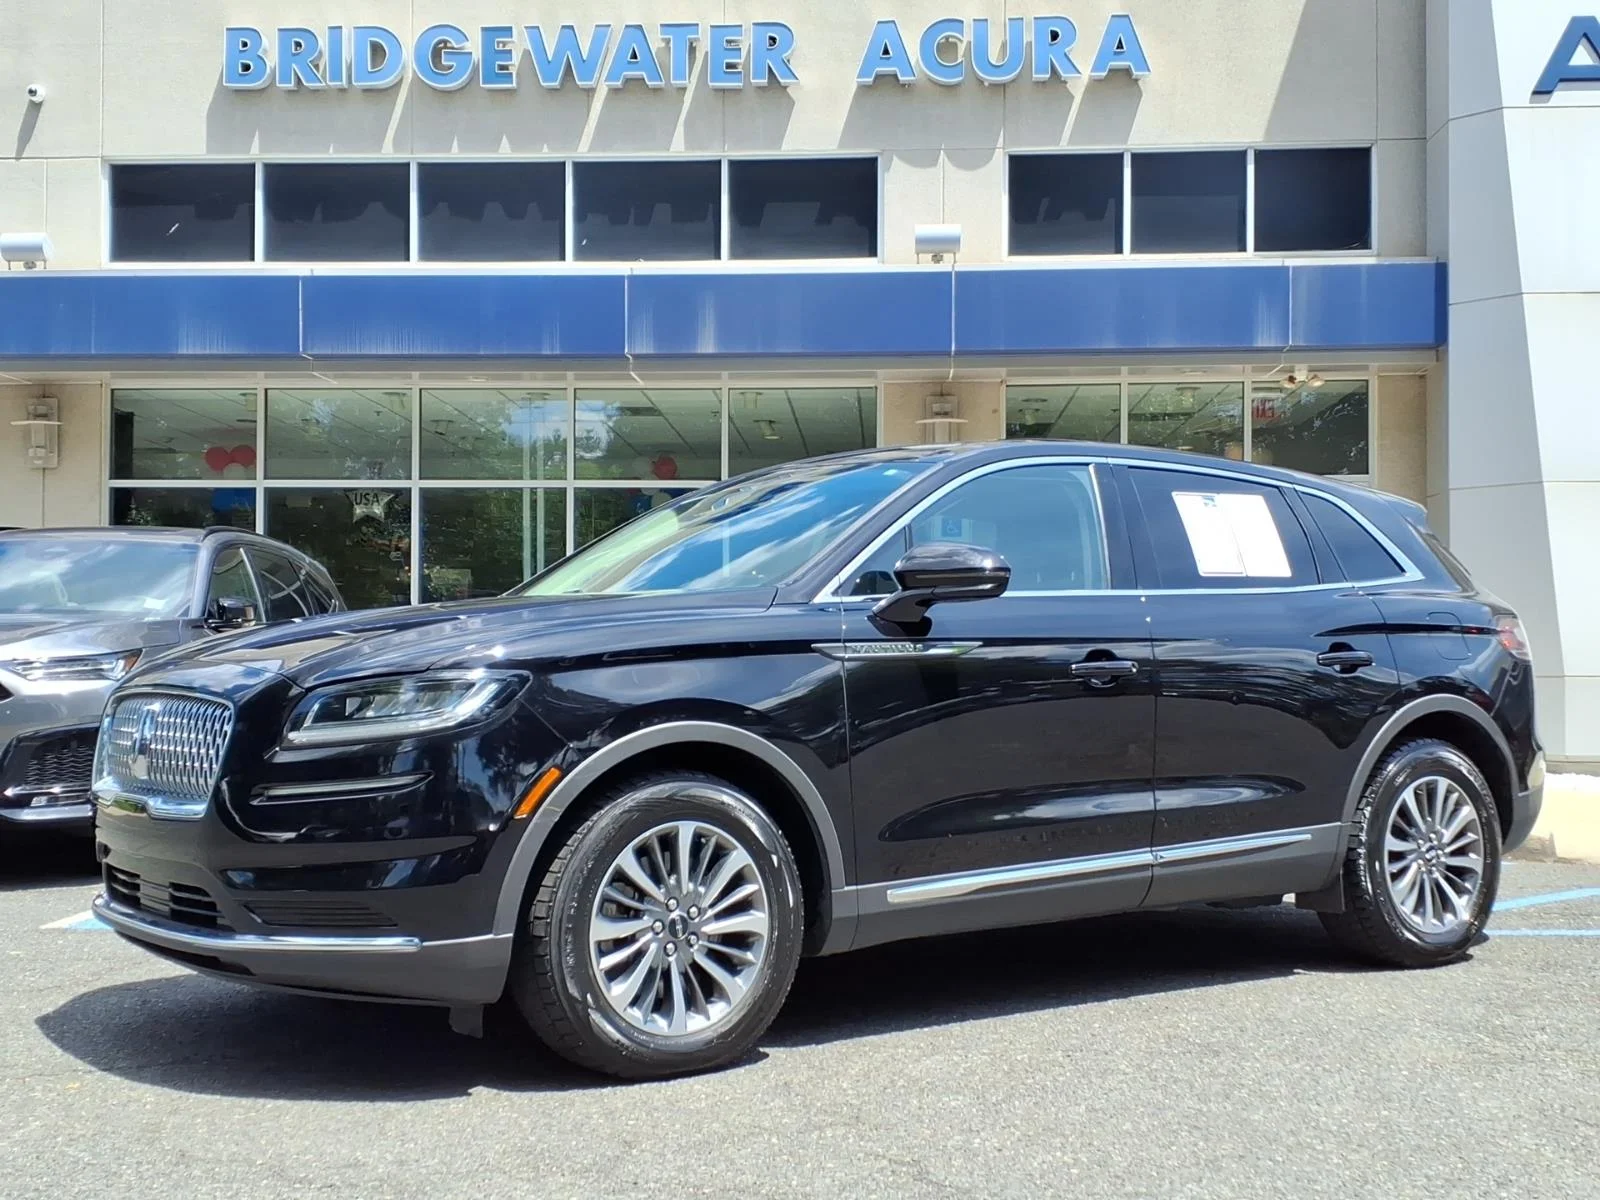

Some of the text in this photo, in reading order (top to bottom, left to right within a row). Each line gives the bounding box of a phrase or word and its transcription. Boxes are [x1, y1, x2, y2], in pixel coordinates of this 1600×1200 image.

[222, 13, 1152, 91] BRIDGEWATER ACURA
[354, 492, 381, 506] USA
